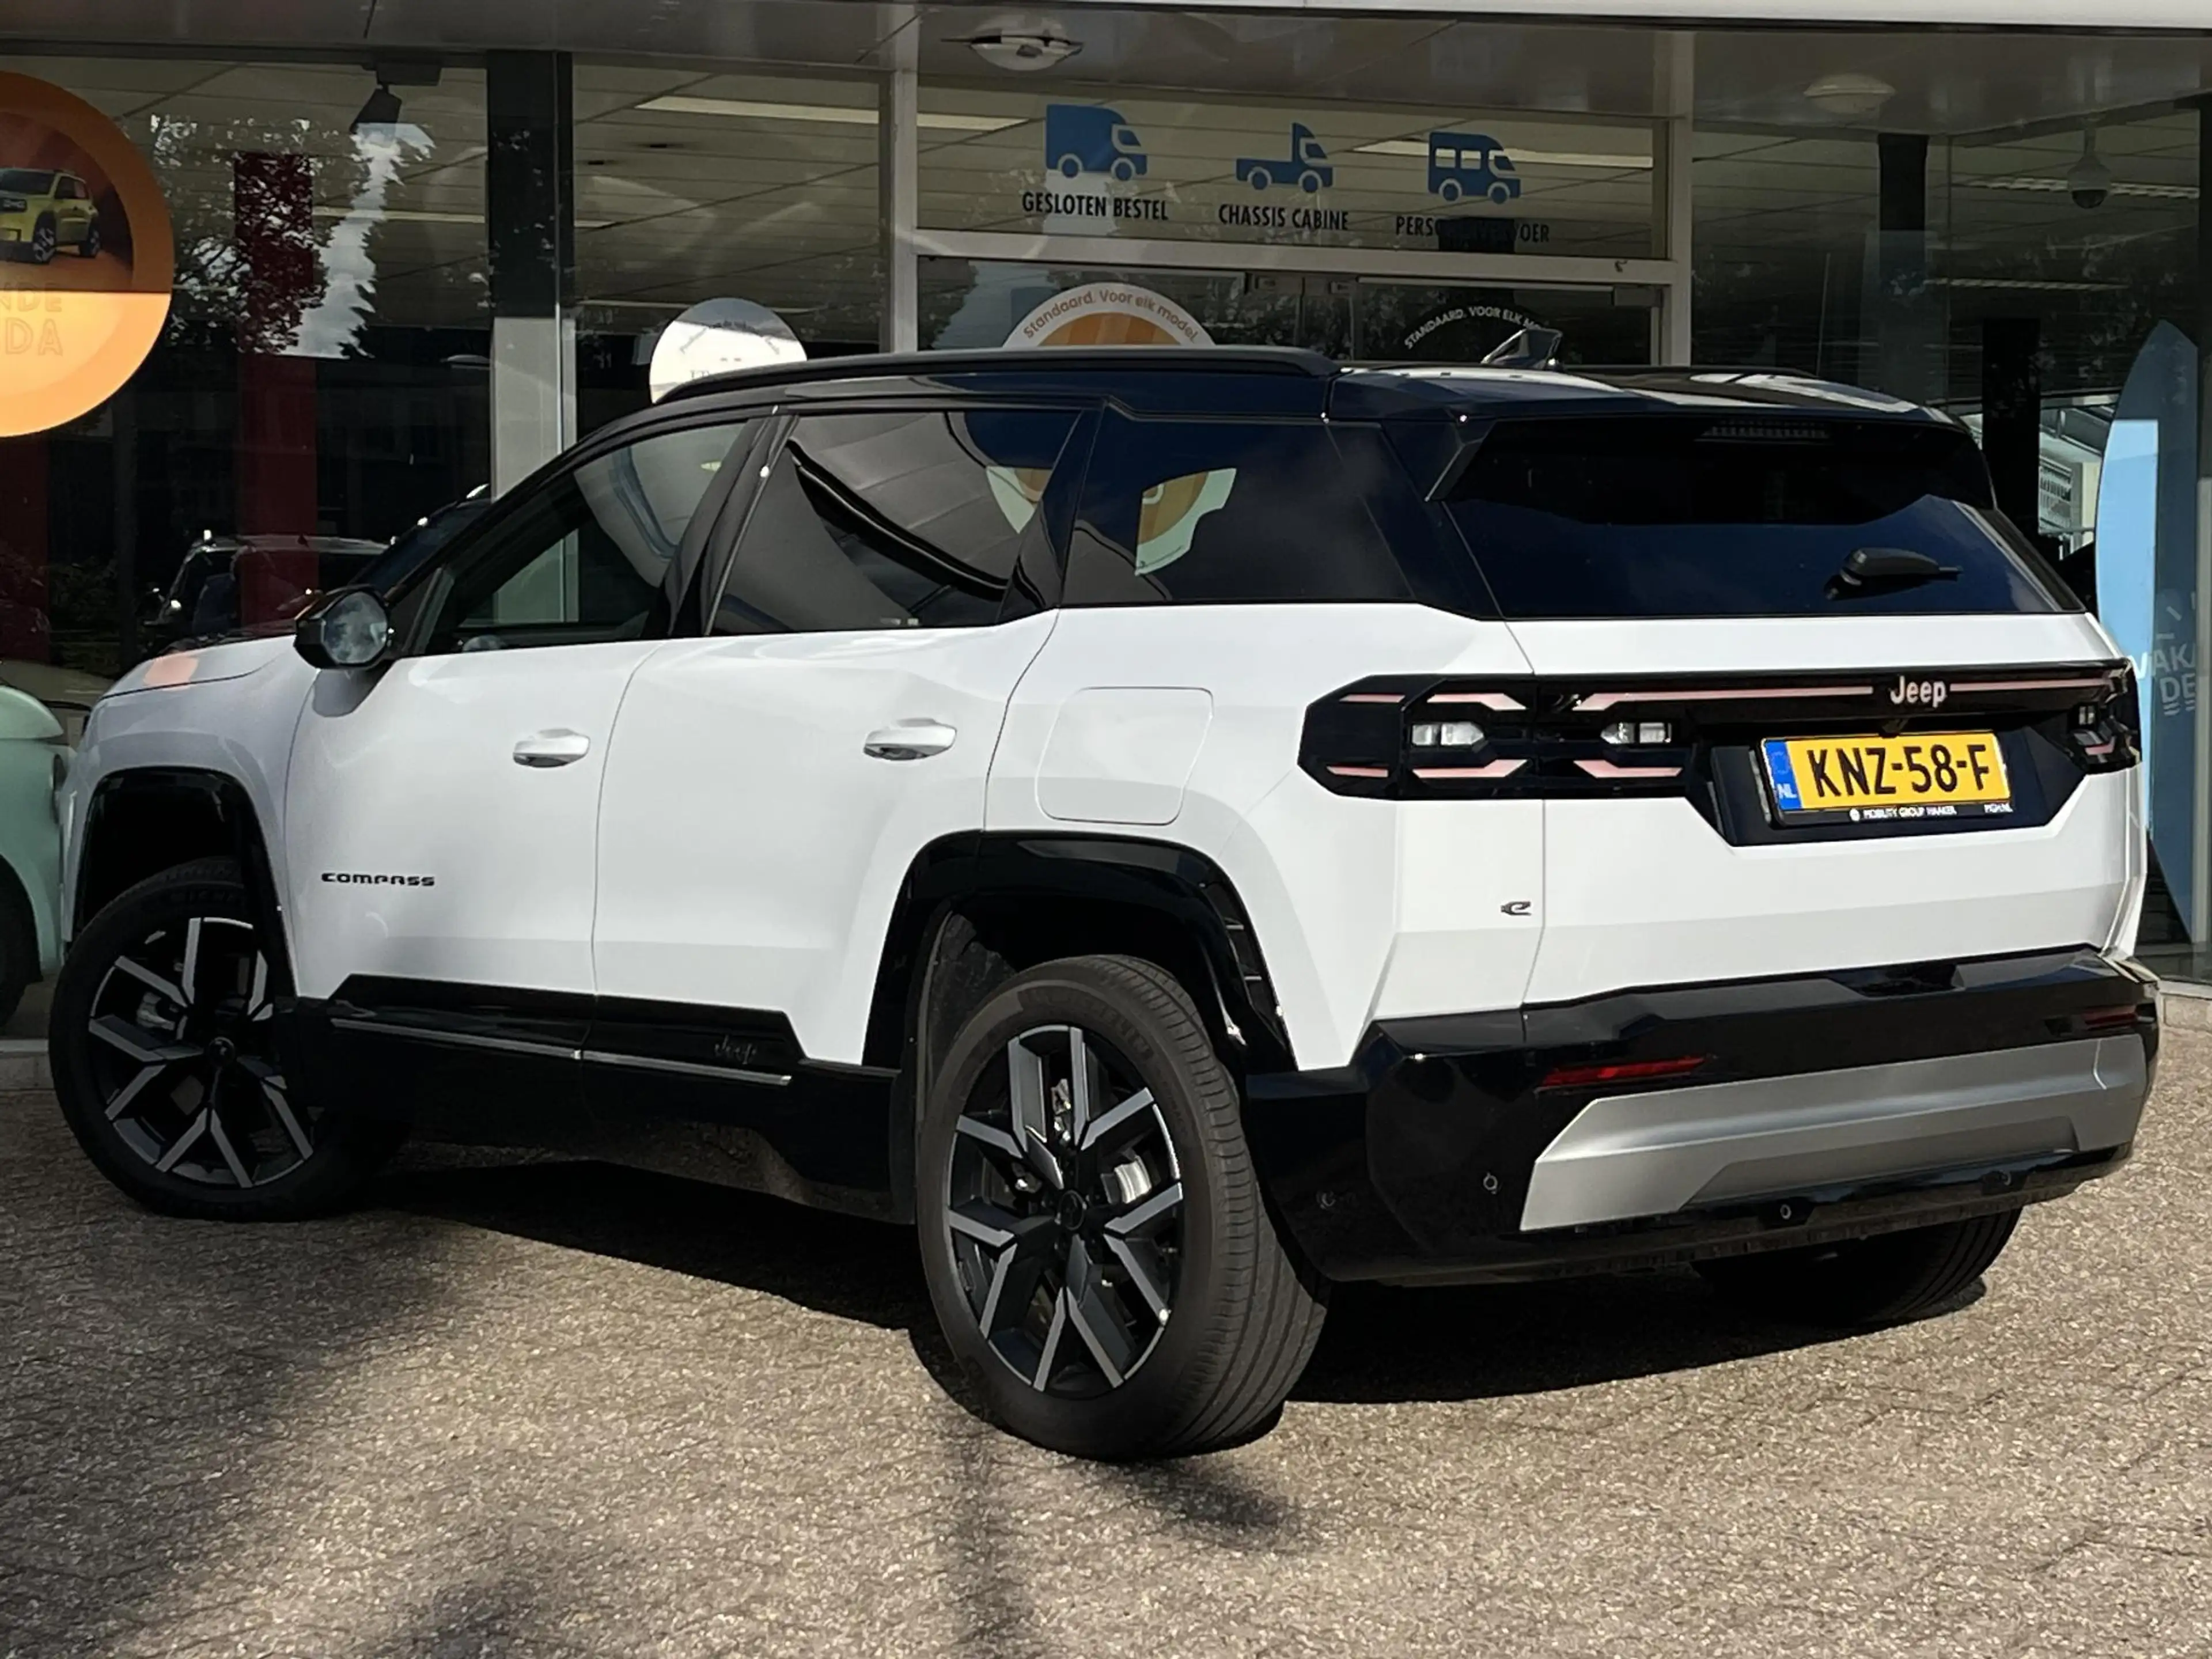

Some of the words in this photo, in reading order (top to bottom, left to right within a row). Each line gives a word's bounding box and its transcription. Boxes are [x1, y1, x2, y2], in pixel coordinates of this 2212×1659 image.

[1022, 191, 1107, 217] GESLOTEN
[1113, 198, 1169, 221] BESTEL
[1218, 203, 1285, 227] CHASSIS
[1292, 209, 1349, 230] CABINE
[1099, 289, 1132, 305] Voor
[1135, 296, 1155, 312] elk
[1157, 305, 1201, 344] model
[1469, 306, 1501, 318] VOOR
[1502, 309, 1523, 325] ELK
[2128, 643, 2195, 679] VAK
[1890, 675, 1946, 708] Jeep
[1777, 783, 1797, 799] NL
[1807, 744, 1989, 797] KNZ-58-F
[321, 867, 435, 886] COMPASS
